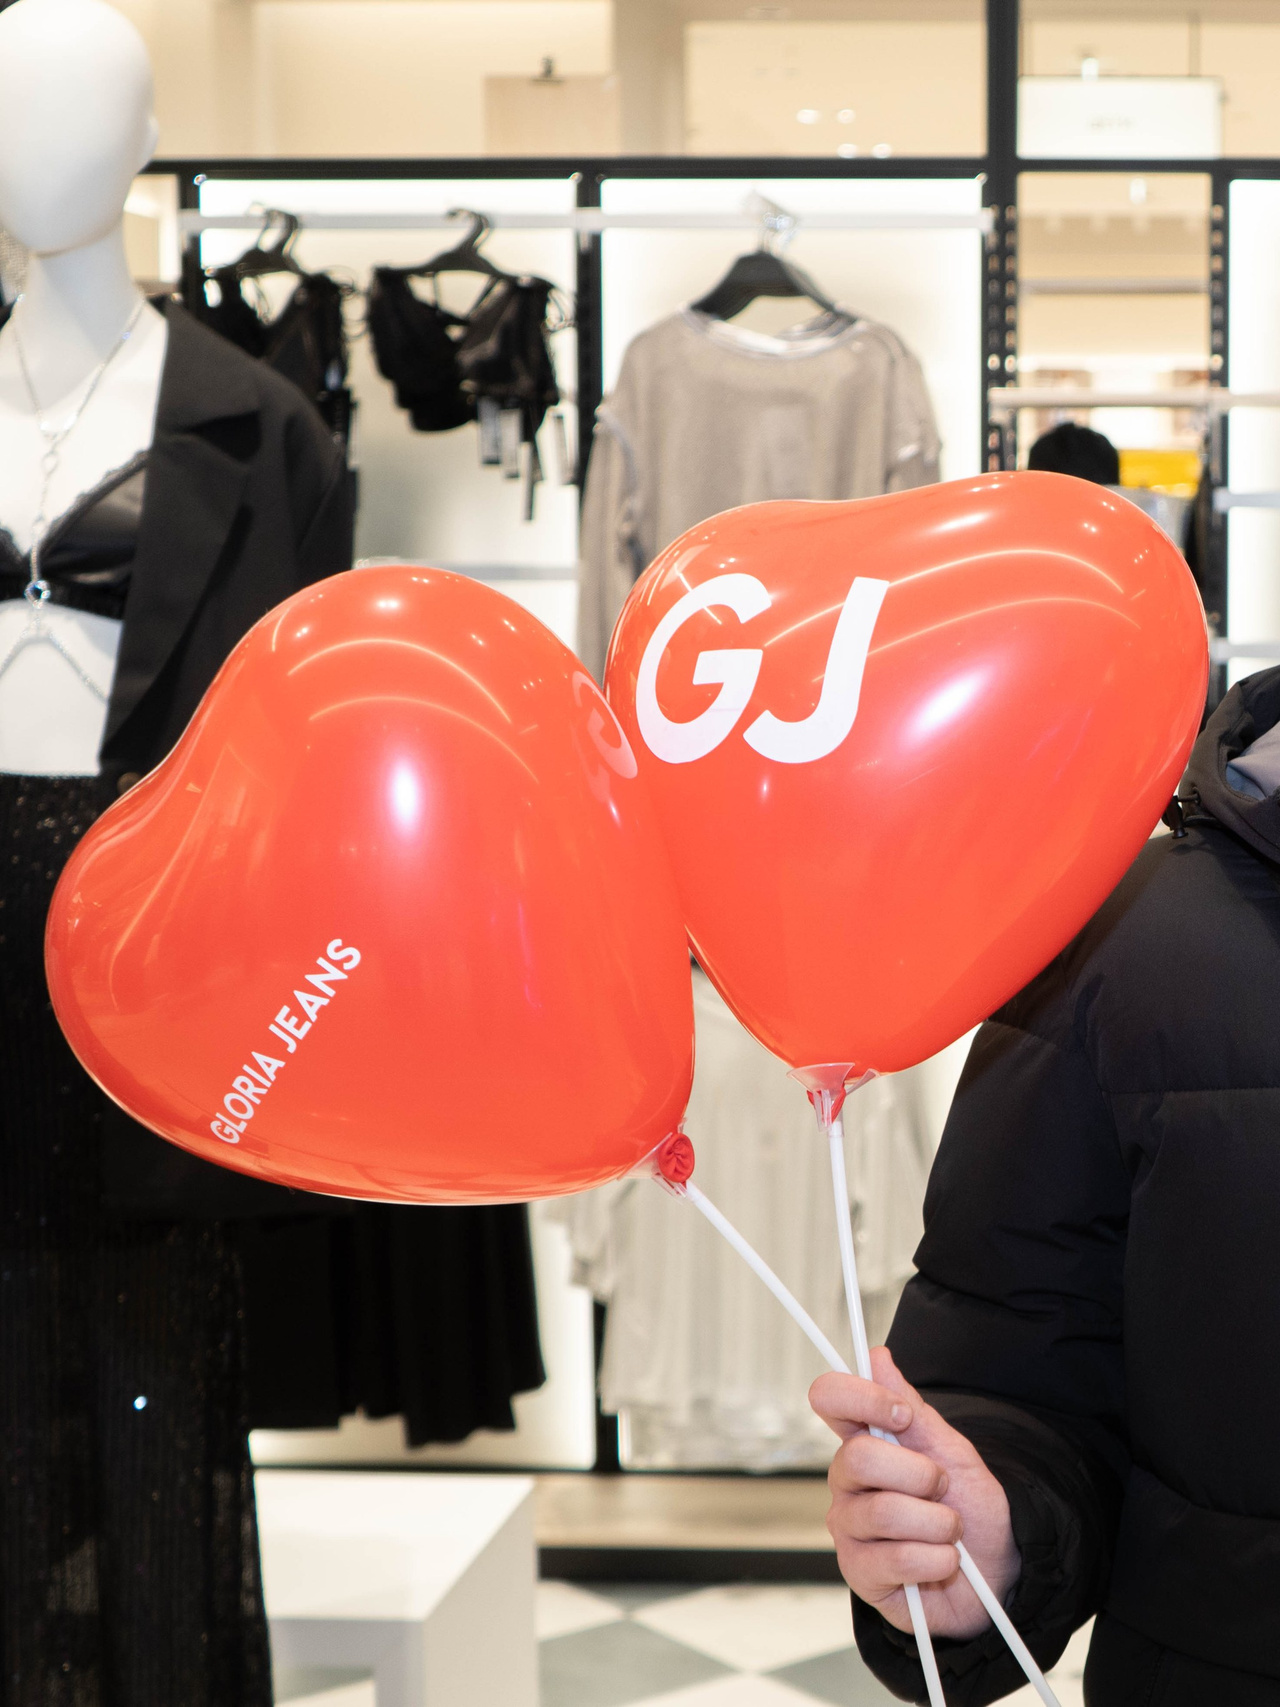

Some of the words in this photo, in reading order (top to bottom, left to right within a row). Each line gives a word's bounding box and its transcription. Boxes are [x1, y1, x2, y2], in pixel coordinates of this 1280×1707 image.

[635, 573, 890, 764] GJ
[209, 1051, 286, 1144] GLORIA
[268, 938, 362, 1054] JEANS
